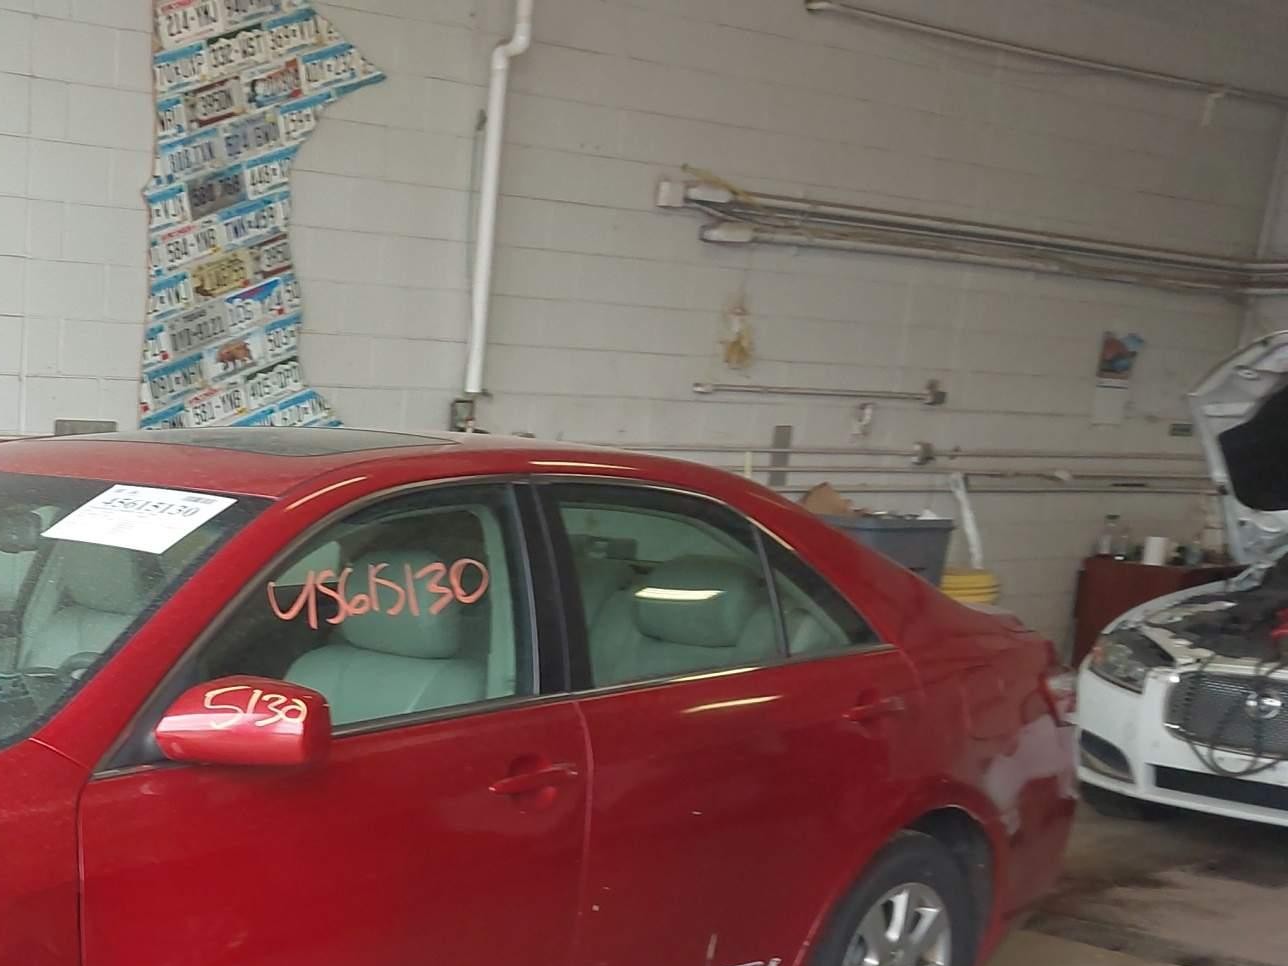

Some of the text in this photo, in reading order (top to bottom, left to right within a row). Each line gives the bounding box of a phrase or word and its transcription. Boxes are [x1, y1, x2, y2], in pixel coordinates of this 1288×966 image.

[103, 498, 201, 518] 45615130
[267, 558, 488, 629] 45615130
[204, 685, 309, 729] 5130
